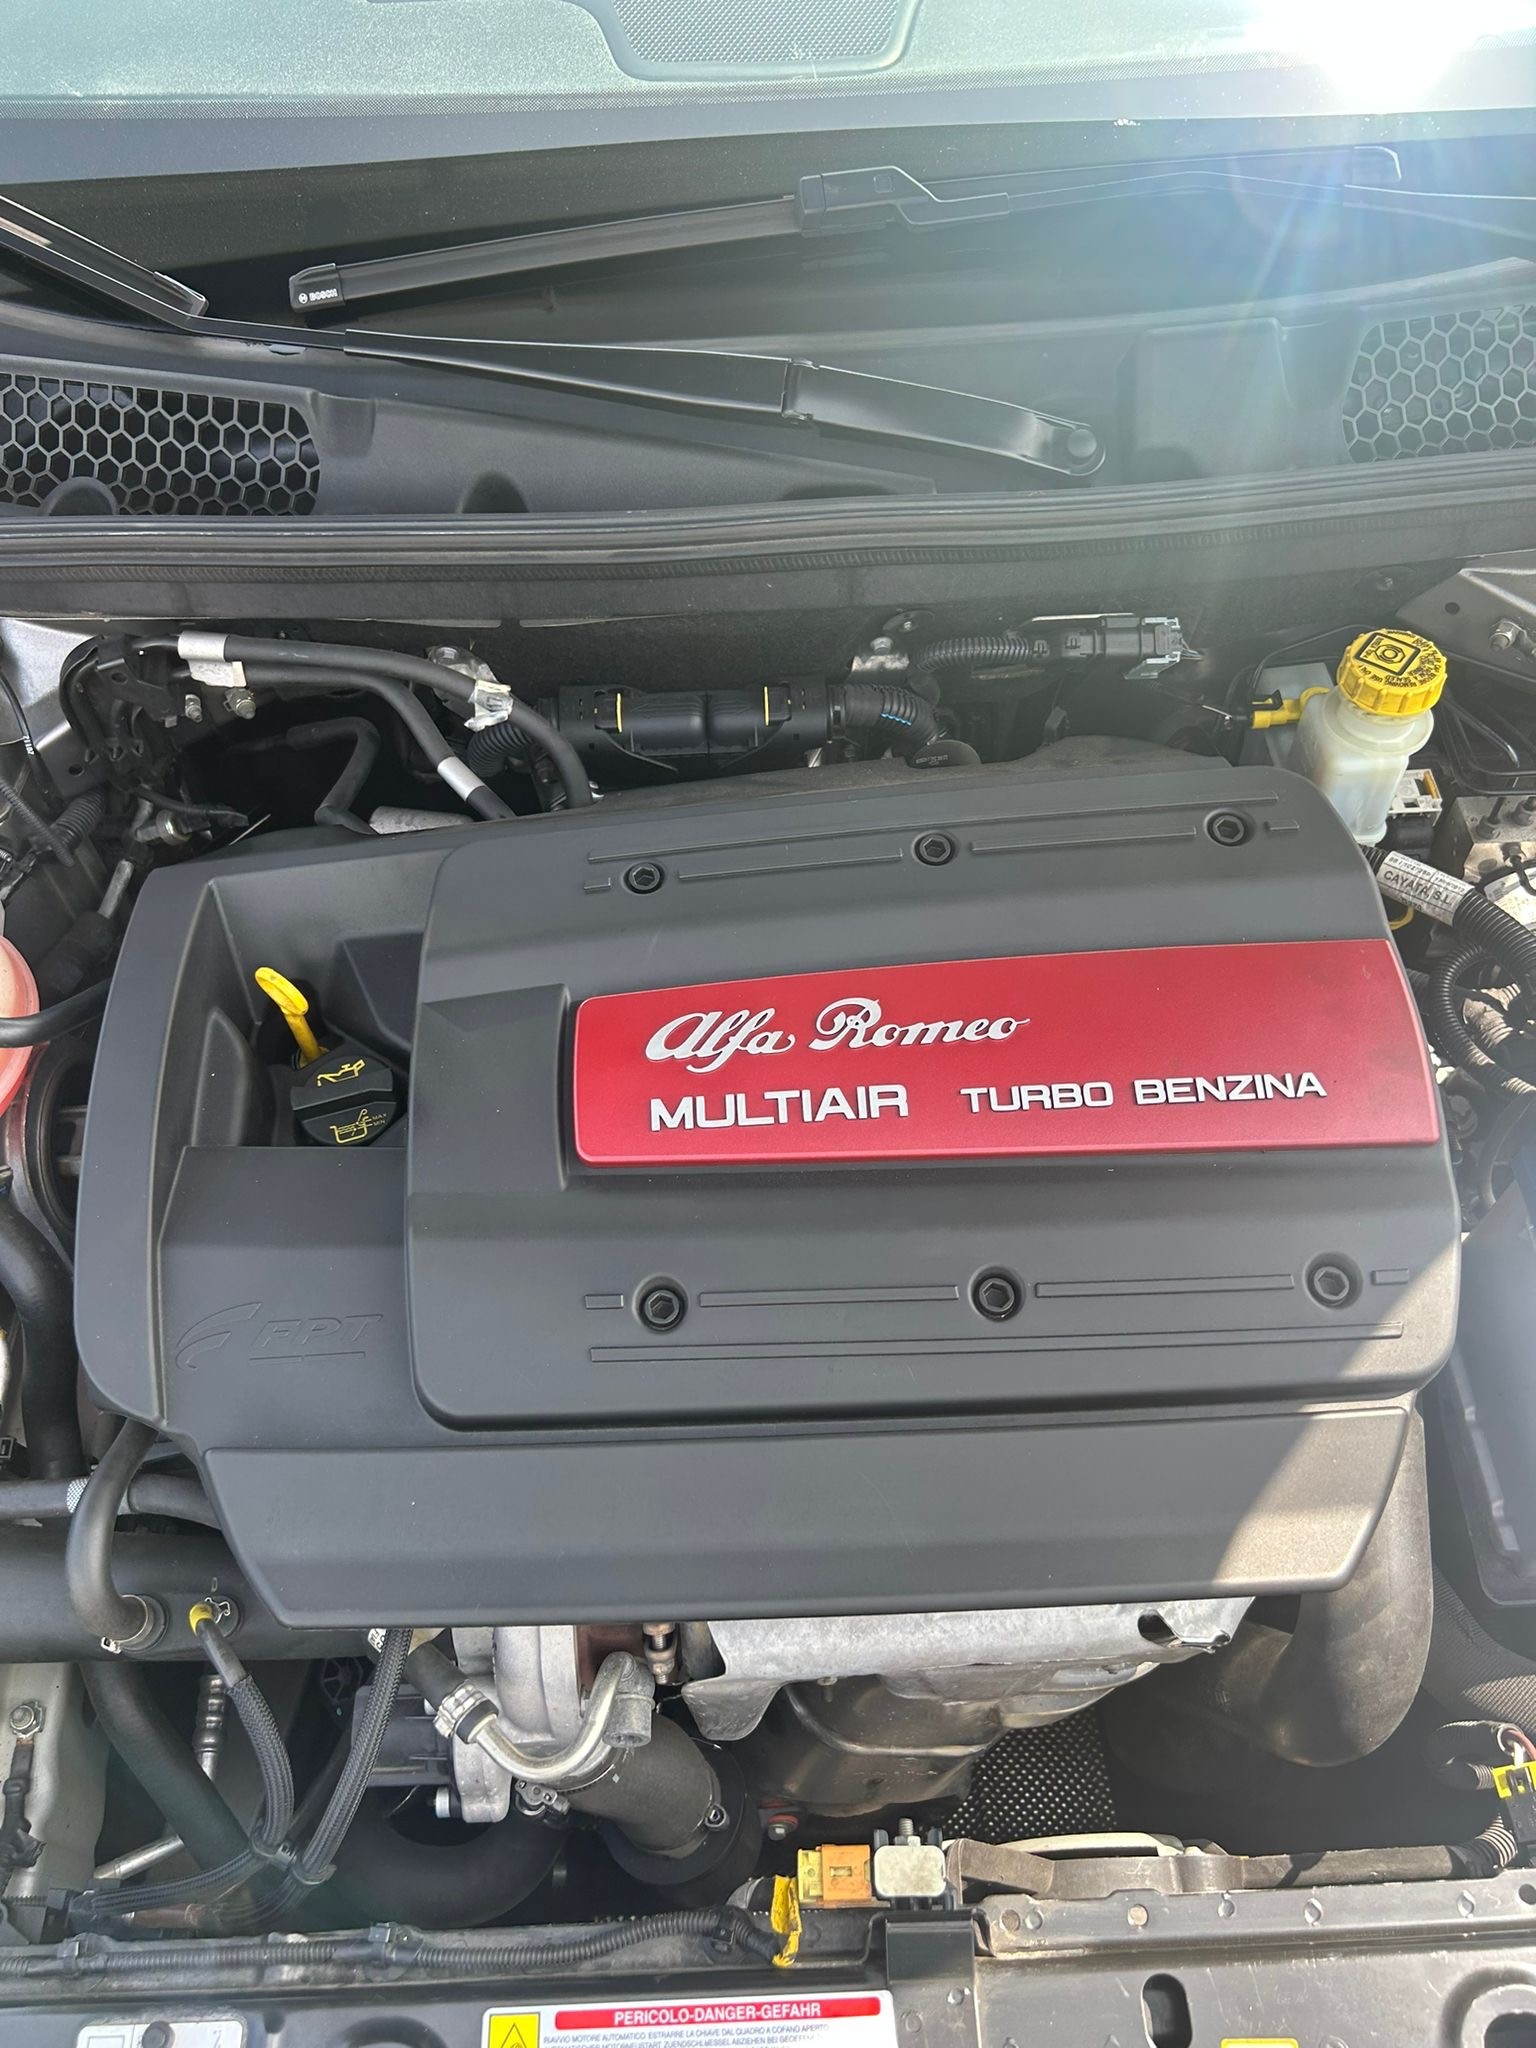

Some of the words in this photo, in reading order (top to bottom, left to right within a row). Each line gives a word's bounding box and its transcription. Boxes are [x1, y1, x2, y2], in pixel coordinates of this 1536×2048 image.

[309, 289, 338, 301] BOSCH
[645, 1007, 796, 1074] Alfa
[809, 997, 1031, 1052] Romeo
[650, 1084, 909, 1132] MULTIAIR
[960, 1081, 1114, 1113] TURBO
[1133, 1072, 1328, 1105] BENZINA
[251, 1314, 384, 1348] FPT
[614, 2003, 822, 2026] PERICOLO-DANGER-GEFAHR
[572, 2034, 601, 2043] MOTORE
[602, 2032, 646, 2041] AUTOMATICO
[648, 2030, 684, 2039] ESTRARRE
[686, 2030, 694, 2039] LA
[695, 2028, 720, 2038] CHIAVE
[721, 2028, 734, 2036] DAL
[735, 2026, 765, 2036] QUADRO
[771, 2024, 801, 2034] COFANO
